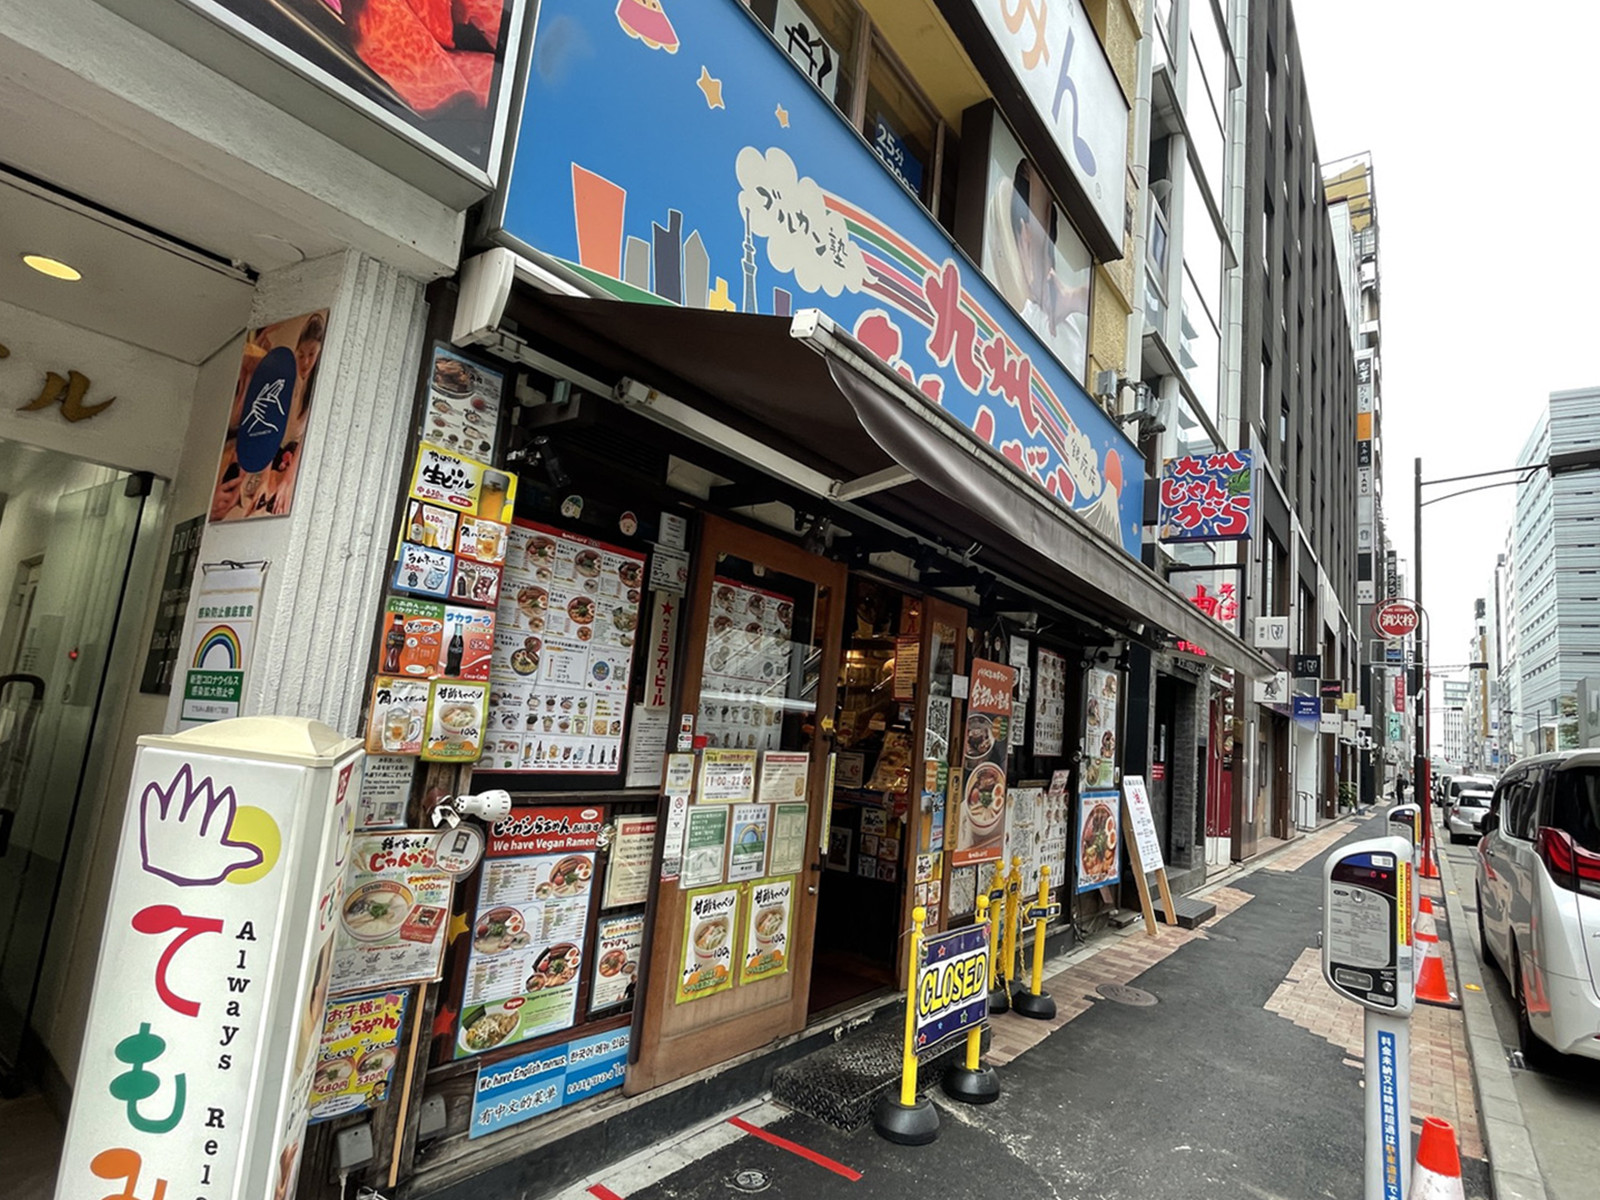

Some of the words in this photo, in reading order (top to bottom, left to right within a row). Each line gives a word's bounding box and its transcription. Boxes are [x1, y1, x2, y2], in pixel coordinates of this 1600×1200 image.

[756, 186, 848, 269] ブルカン塾
[925, 263, 1040, 434] 九州
[422, 464, 475, 490] 生ビール
[1175, 452, 1245, 477] 九州
[1161, 479, 1227, 508] じゃん
[1173, 496, 1250, 536] がら
[446, 612, 492, 627] コカコーラ
[1382, 613, 1415, 627] 消火栓
[190, 674, 240, 686] 新型コロナウイルス
[493, 841, 509, 851] We
[511, 839, 534, 851] have
[536, 838, 564, 851] Vegan
[566, 837, 595, 847] Ramen
[218, 920, 257, 1072] Always
[919, 952, 987, 1018] CLOSED
[493, 1071, 512, 1087] have
[513, 1062, 541, 1080] English
[197, 1107, 226, 1200] Rel
